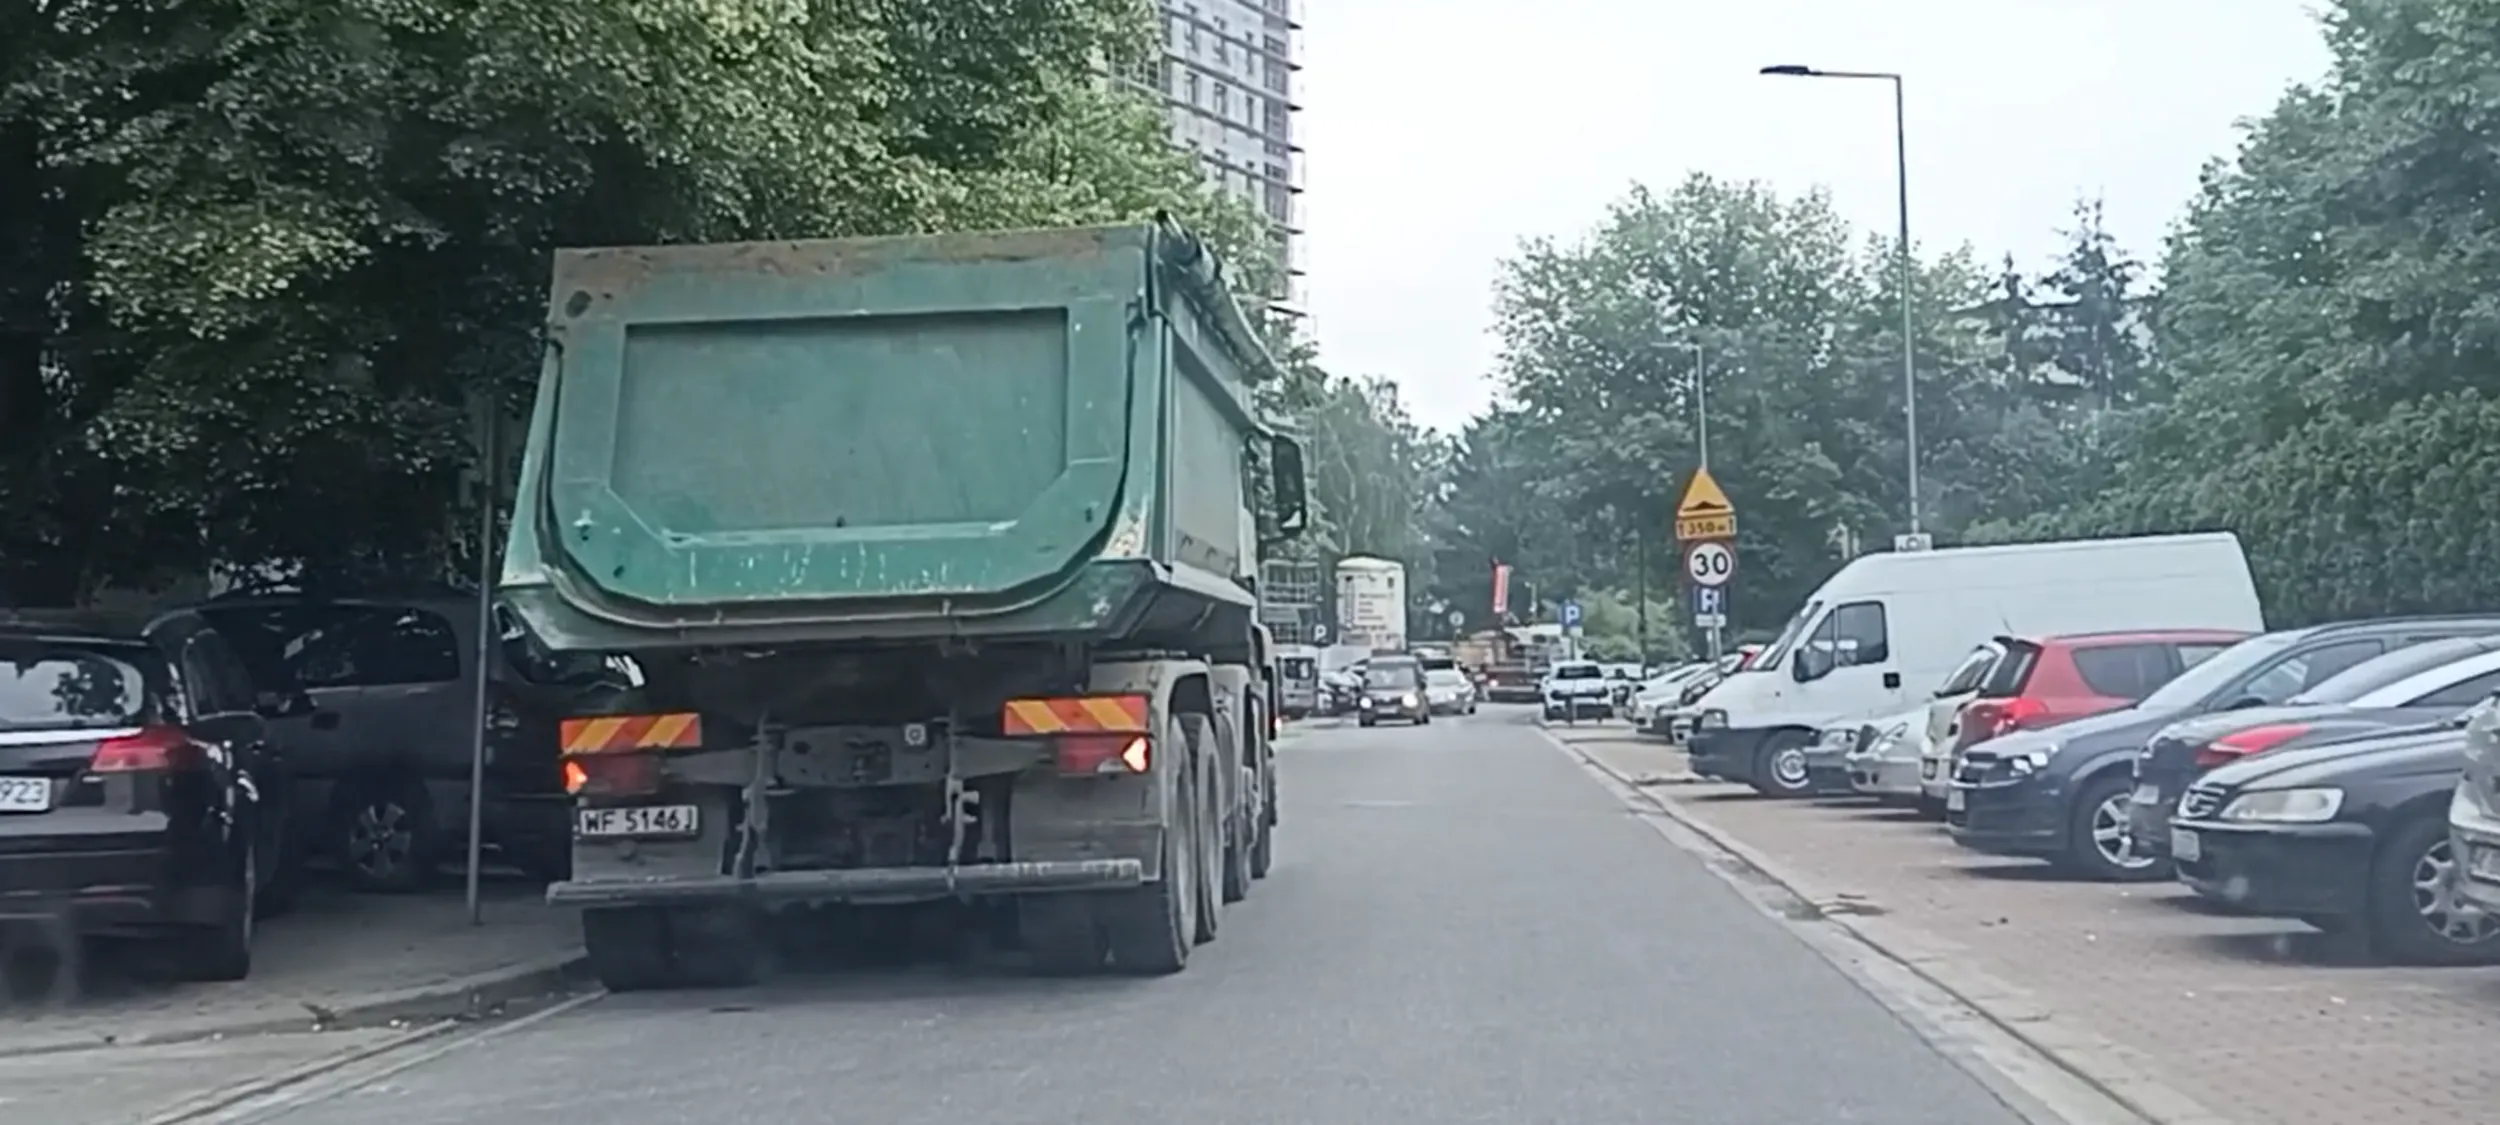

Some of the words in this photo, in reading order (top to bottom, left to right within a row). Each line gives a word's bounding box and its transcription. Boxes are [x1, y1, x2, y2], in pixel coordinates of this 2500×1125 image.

[1694, 551, 1728, 576] 30
[1564, 605, 1579, 624] P
[1314, 625, 1326, 641] P
[0, 779, 44, 804] 923
[584, 810, 616, 832] WF
[625, 807, 692, 832] 5146J
